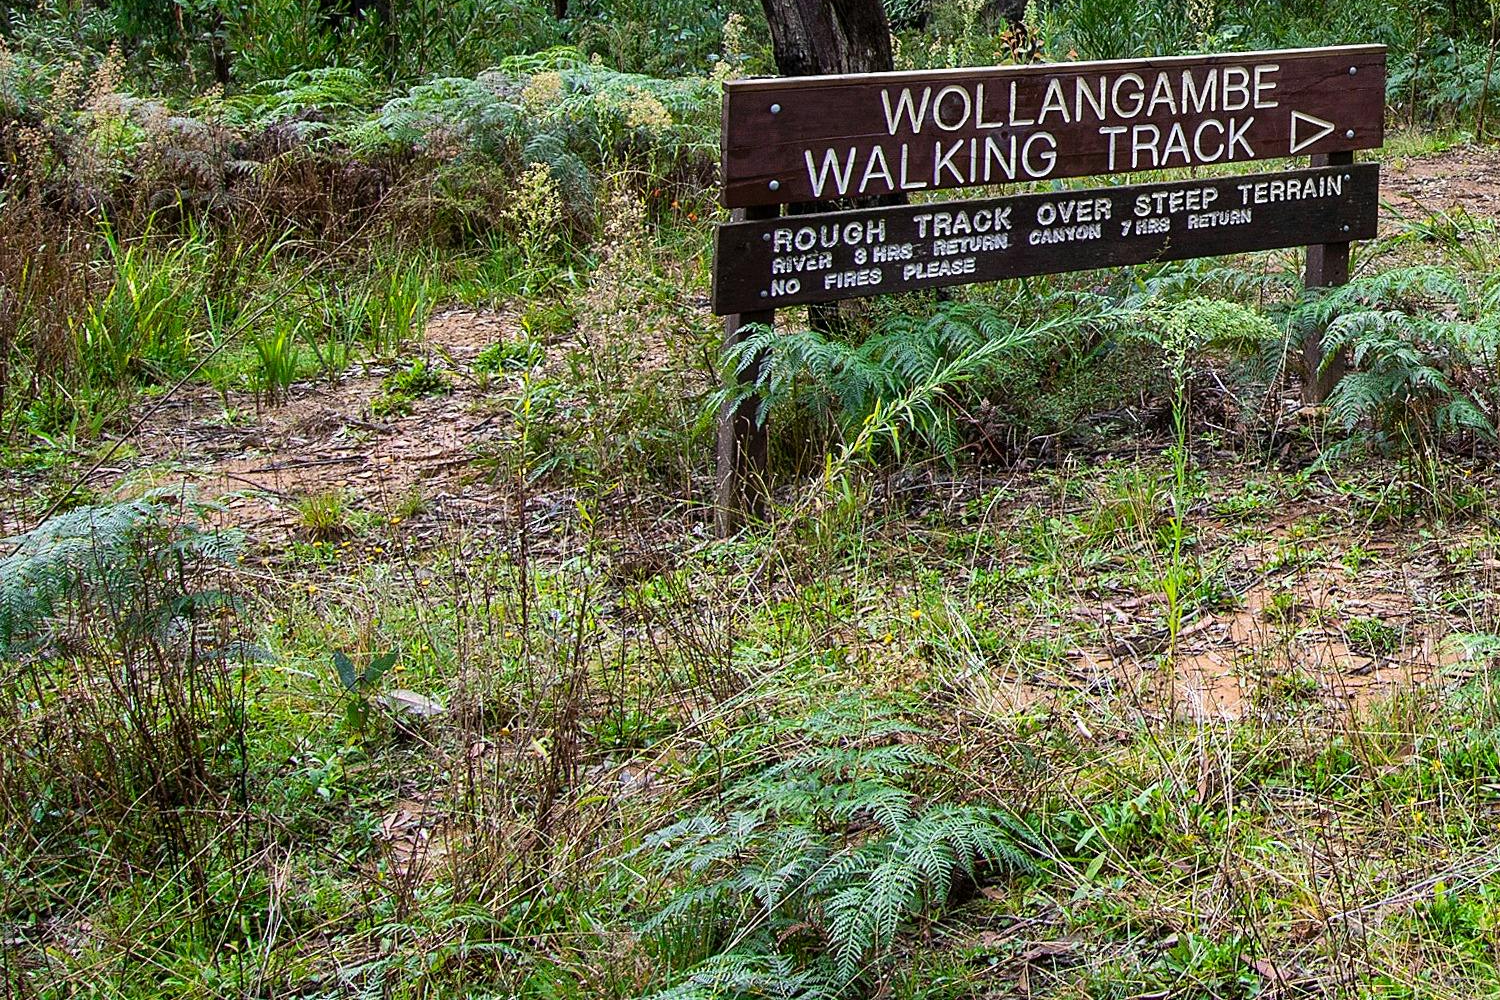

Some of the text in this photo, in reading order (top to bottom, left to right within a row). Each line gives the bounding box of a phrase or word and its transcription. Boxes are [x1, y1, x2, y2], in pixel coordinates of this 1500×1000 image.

[881, 64, 1279, 135] WOLLANGAMBE
[804, 116, 1255, 198] WALKING TRACK
[772, 208, 1252, 274] RIVER 3 HRS RETURN CANYON 7 HRS RETURN
[773, 175, 1342, 252] ROUGH TRACK OVER STEEP TERRAIN
[771, 257, 976, 297] NO FIRES PLEASE
